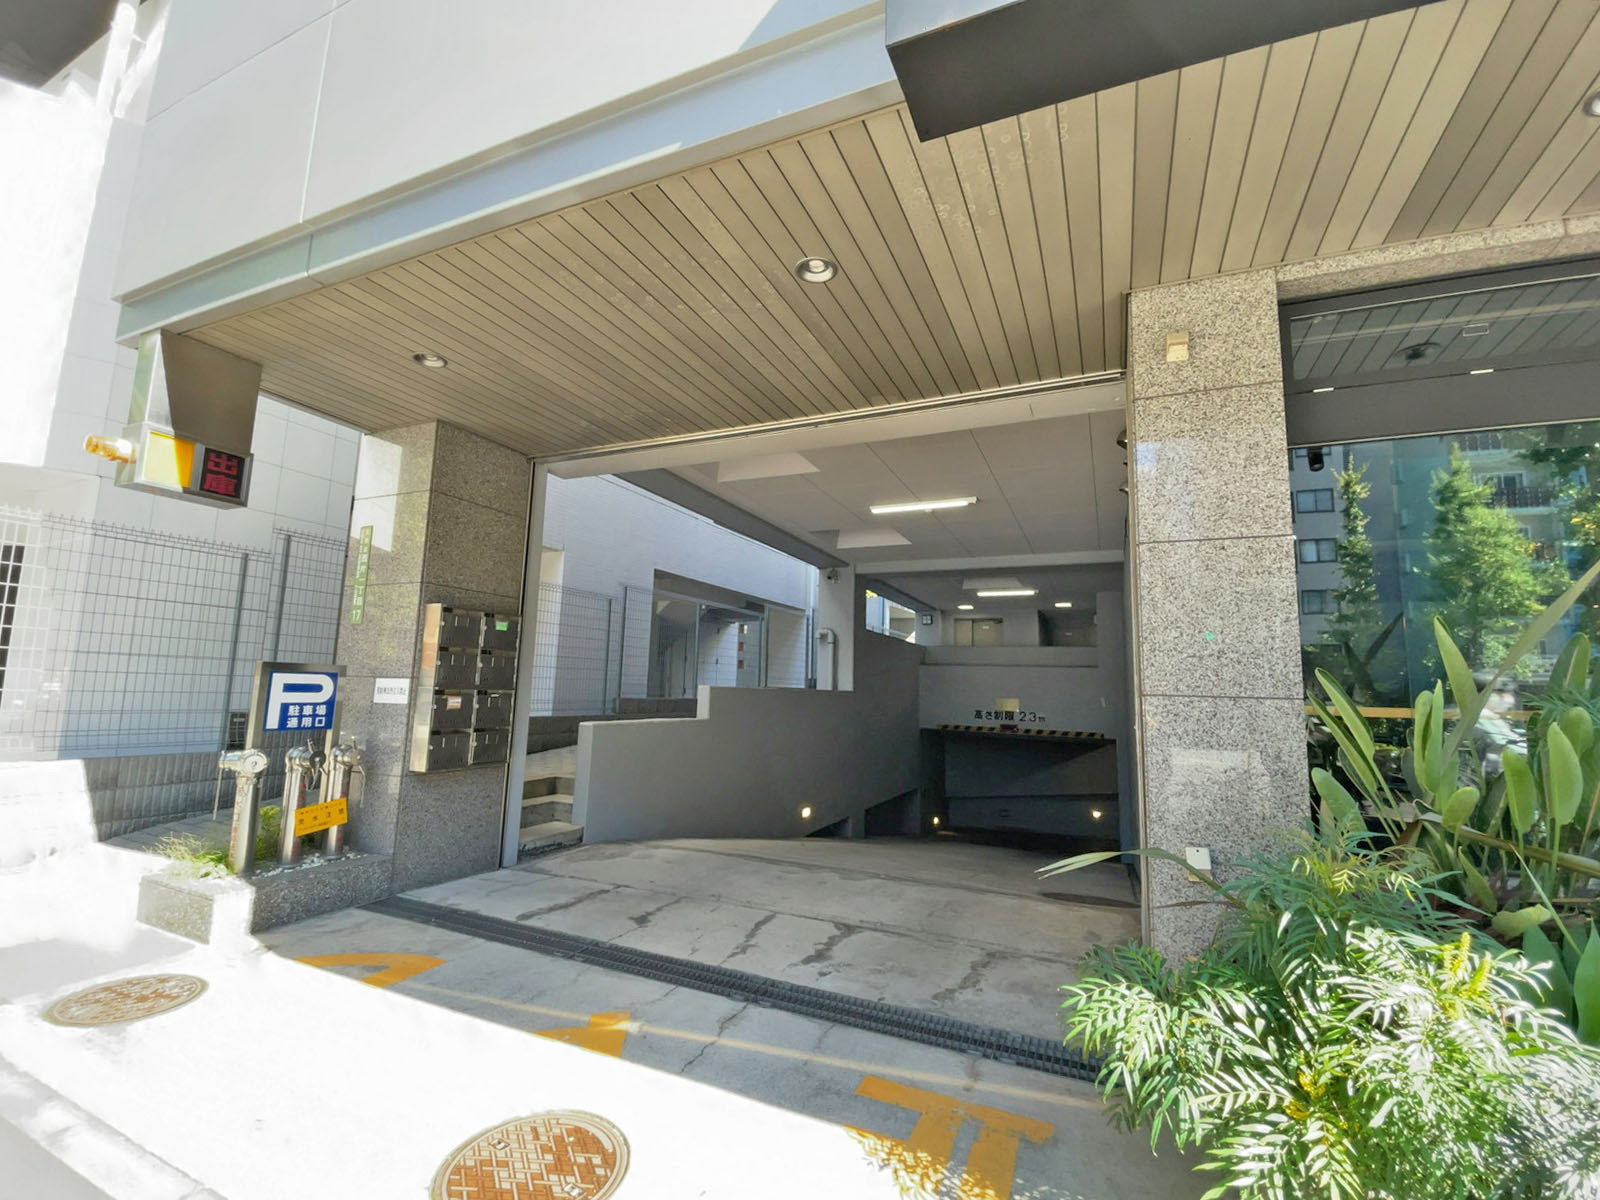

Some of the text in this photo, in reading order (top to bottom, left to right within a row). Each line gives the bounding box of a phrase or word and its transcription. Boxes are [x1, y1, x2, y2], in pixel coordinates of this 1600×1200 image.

[266, 673, 334, 729] P
[287, 704, 327, 716] 駐車場
